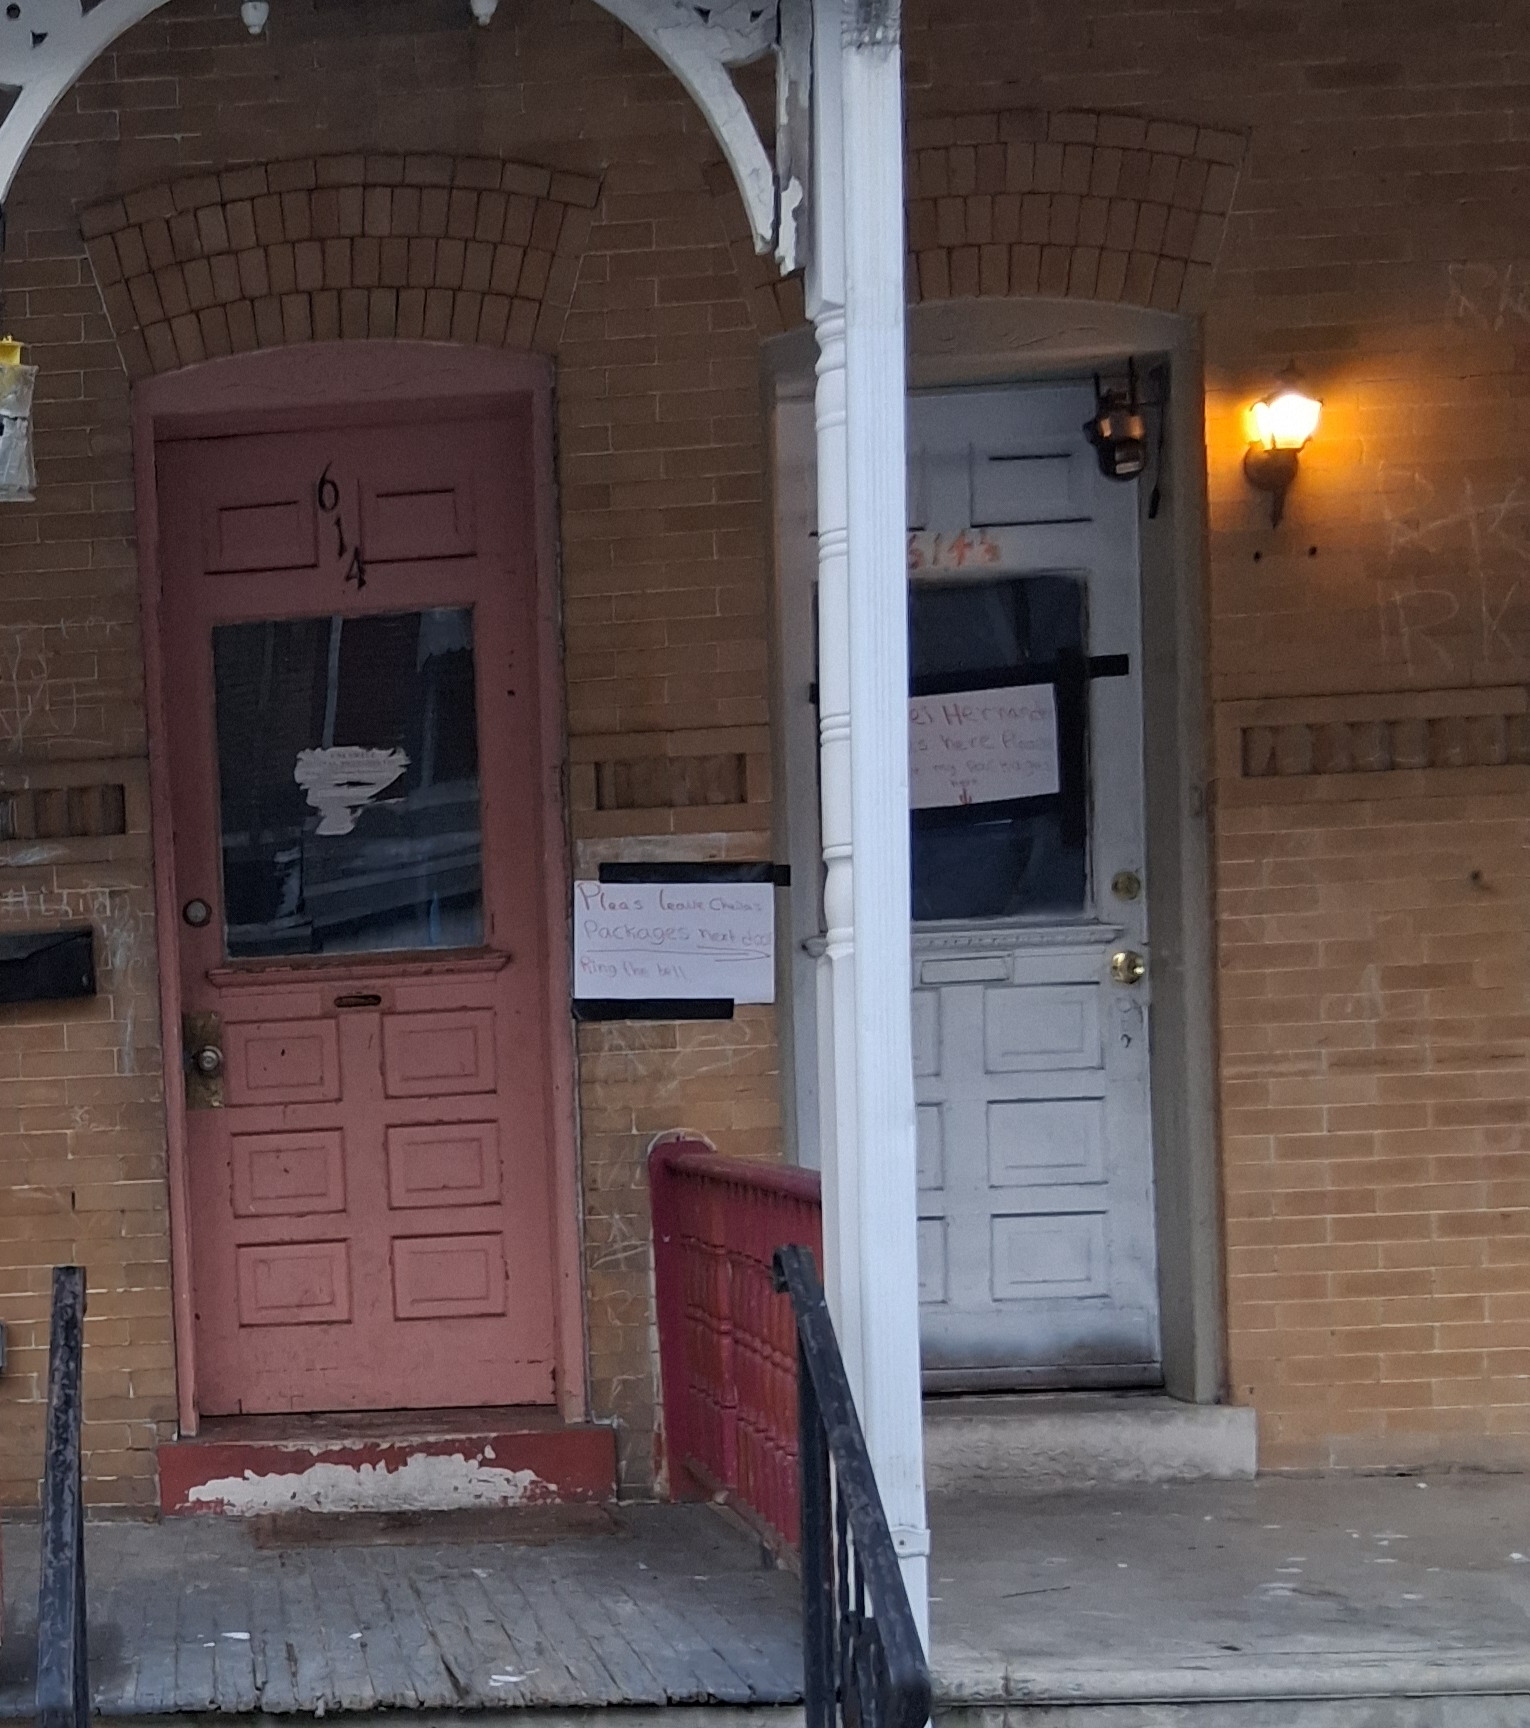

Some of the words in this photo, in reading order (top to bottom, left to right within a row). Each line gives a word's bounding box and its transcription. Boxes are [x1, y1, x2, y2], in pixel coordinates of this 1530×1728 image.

[318, 461, 367, 590] 614
[584, 920, 690, 946] Packages
[698, 928, 736, 943] next
[580, 956, 617, 978] Ring
